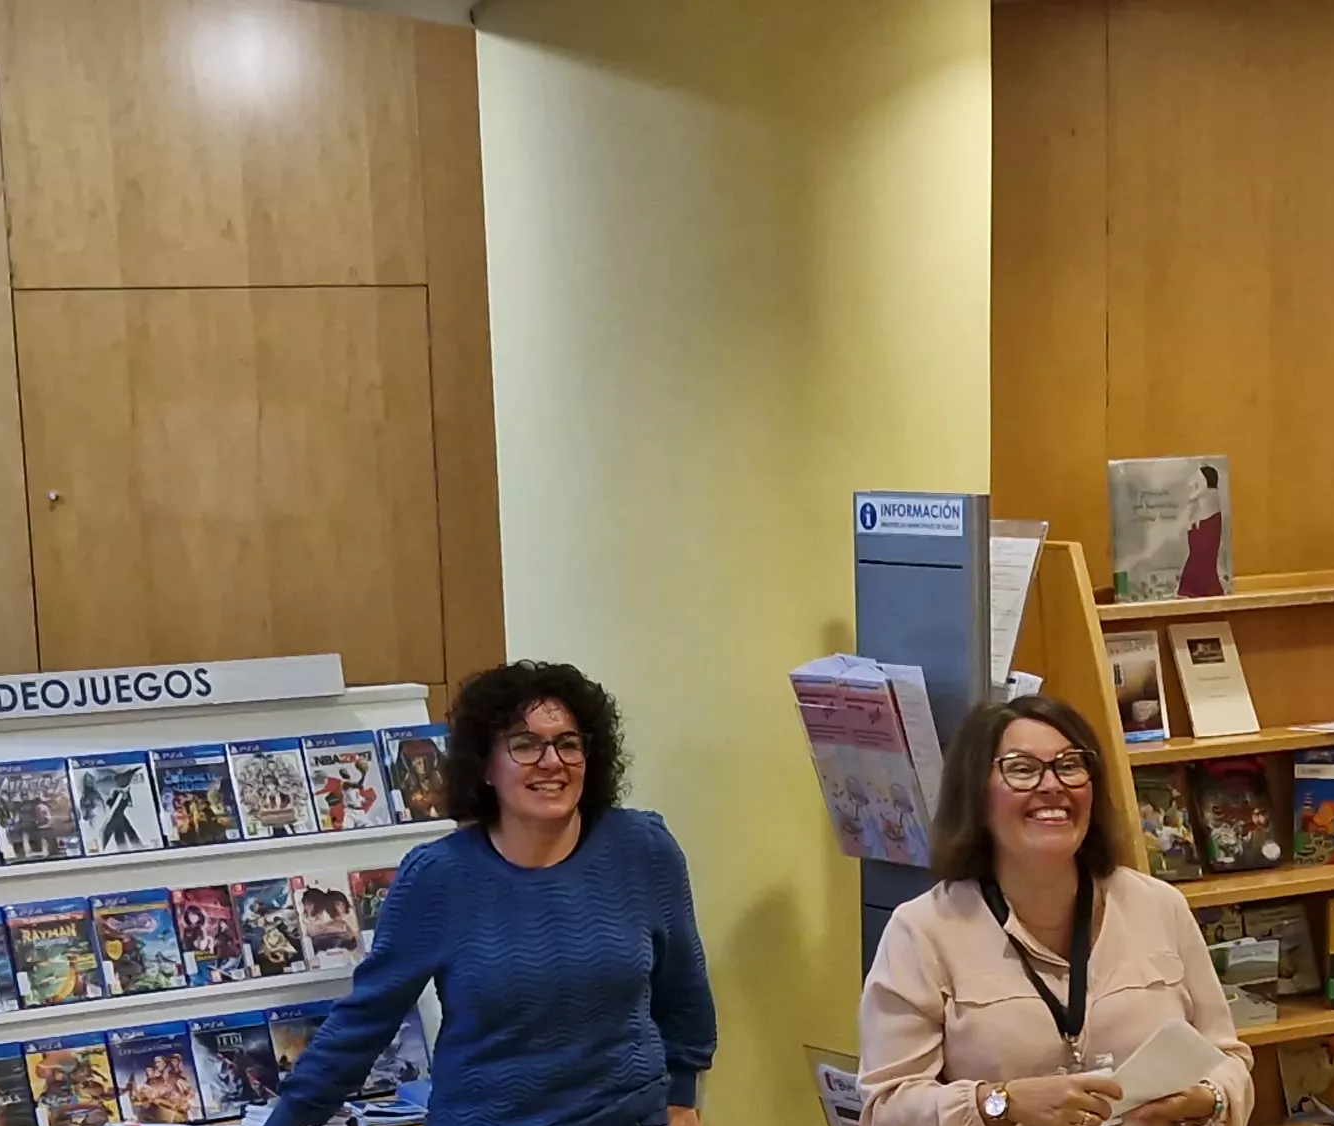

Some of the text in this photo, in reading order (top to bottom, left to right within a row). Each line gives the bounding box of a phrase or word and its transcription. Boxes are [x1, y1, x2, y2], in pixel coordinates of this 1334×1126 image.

[880, 500, 961, 519] INFORMACIÓN
[314, 754, 339, 766] NBA
[20, 922, 78, 944] RAYMAN
